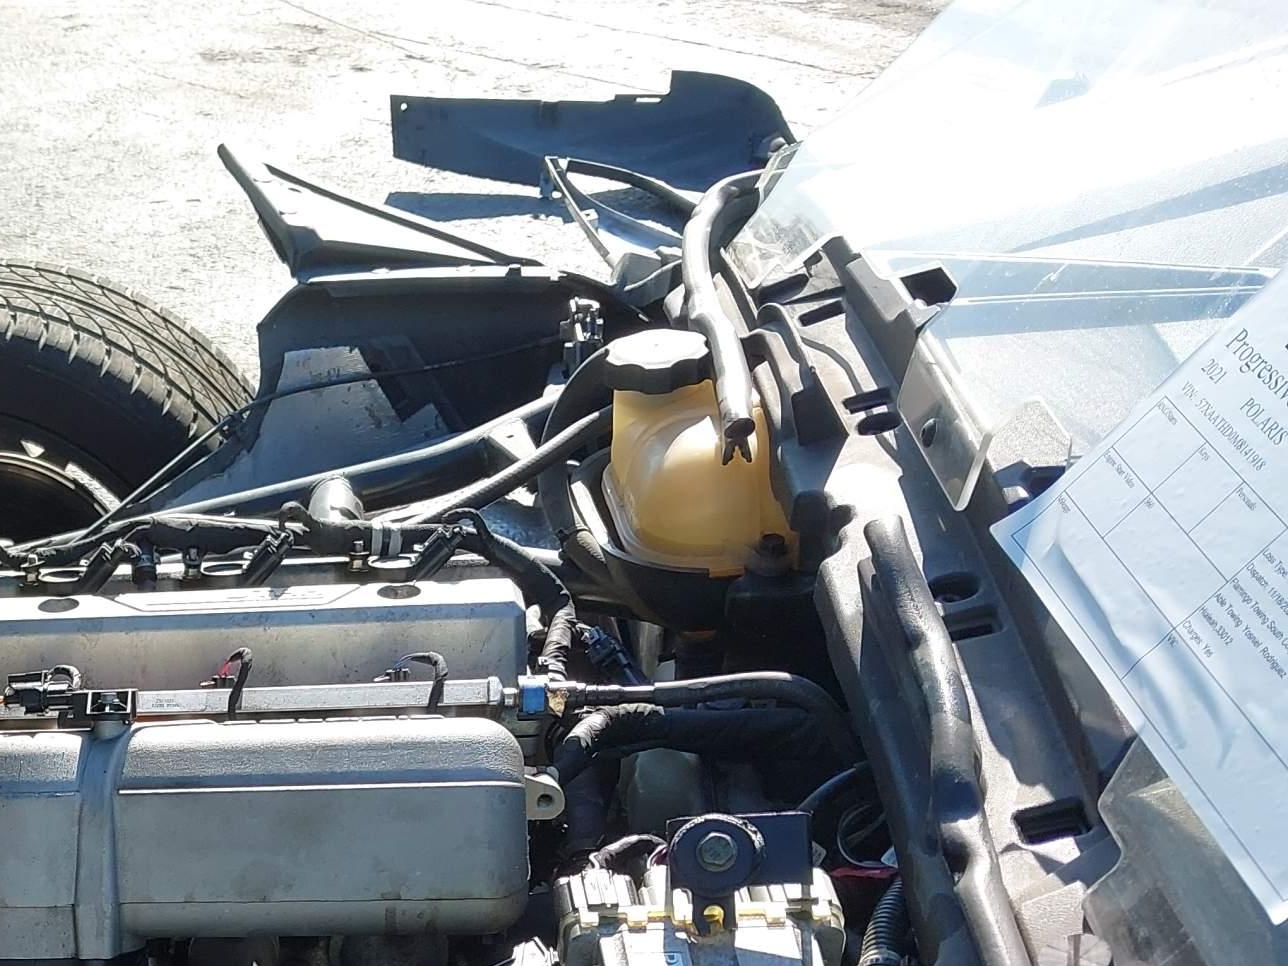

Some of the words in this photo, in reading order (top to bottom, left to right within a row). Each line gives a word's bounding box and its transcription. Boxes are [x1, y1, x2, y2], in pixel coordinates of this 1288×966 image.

[1181, 380, 1199, 401] VIN:
[1200, 358, 1228, 385] 2021
[1239, 397, 1288, 446] POLARIS
[1262, 547, 1277, 565] Loss
[1267, 587, 1288, 616] 11/18/20
[1249, 600, 1270, 626] Towing
[1266, 620, 1284, 641] South
[1202, 643, 1214, 658] Yes
[1213, 592, 1227, 608] Able
[1224, 603, 1243, 628] Towing
[1259, 646, 1287, 680] Rodriguez
